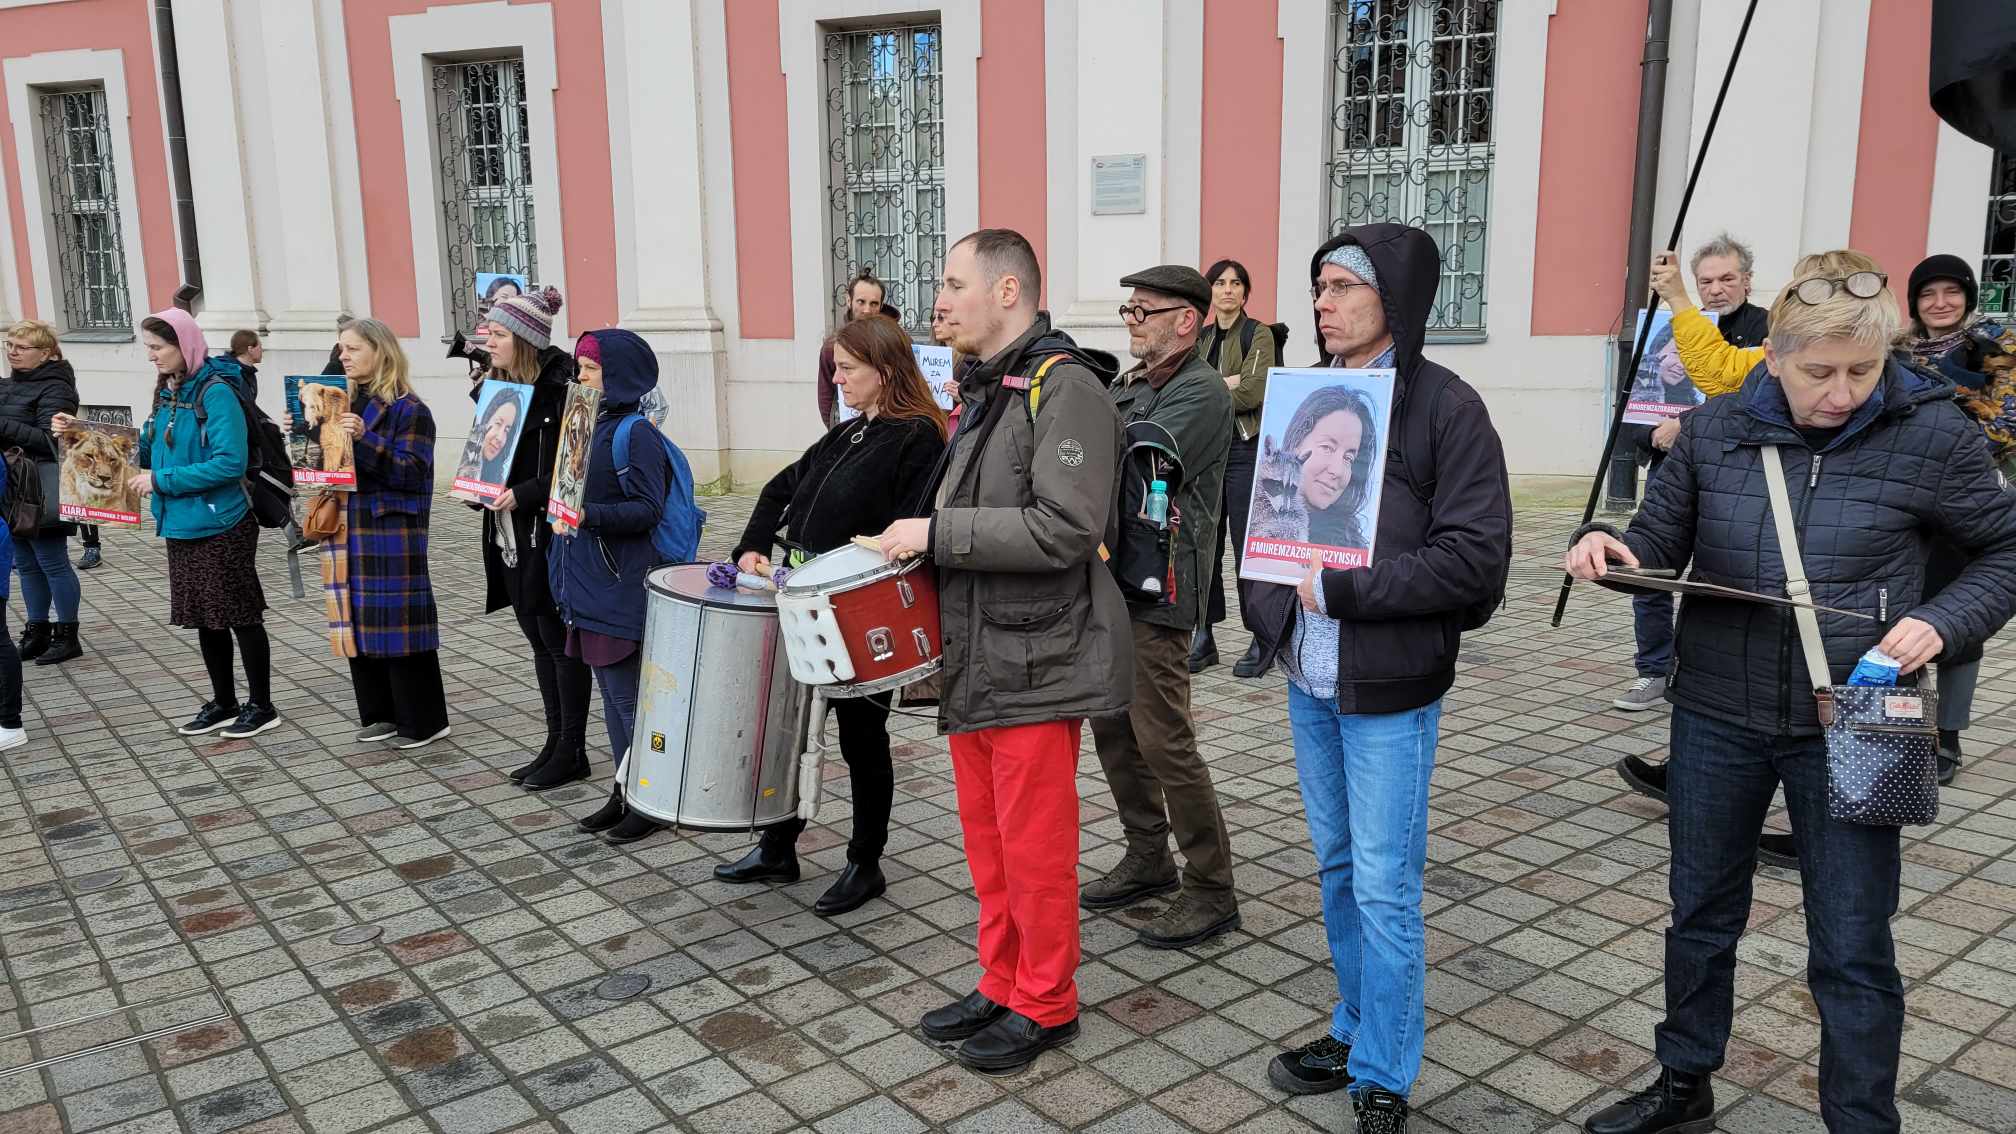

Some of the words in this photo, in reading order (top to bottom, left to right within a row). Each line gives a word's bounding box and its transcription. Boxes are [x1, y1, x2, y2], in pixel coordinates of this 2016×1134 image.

[922, 355, 951, 368] MUREM
[61, 505, 87, 517] KIARA
[1250, 541, 1362, 566] #MUREMZAZGRCZYNSKA
